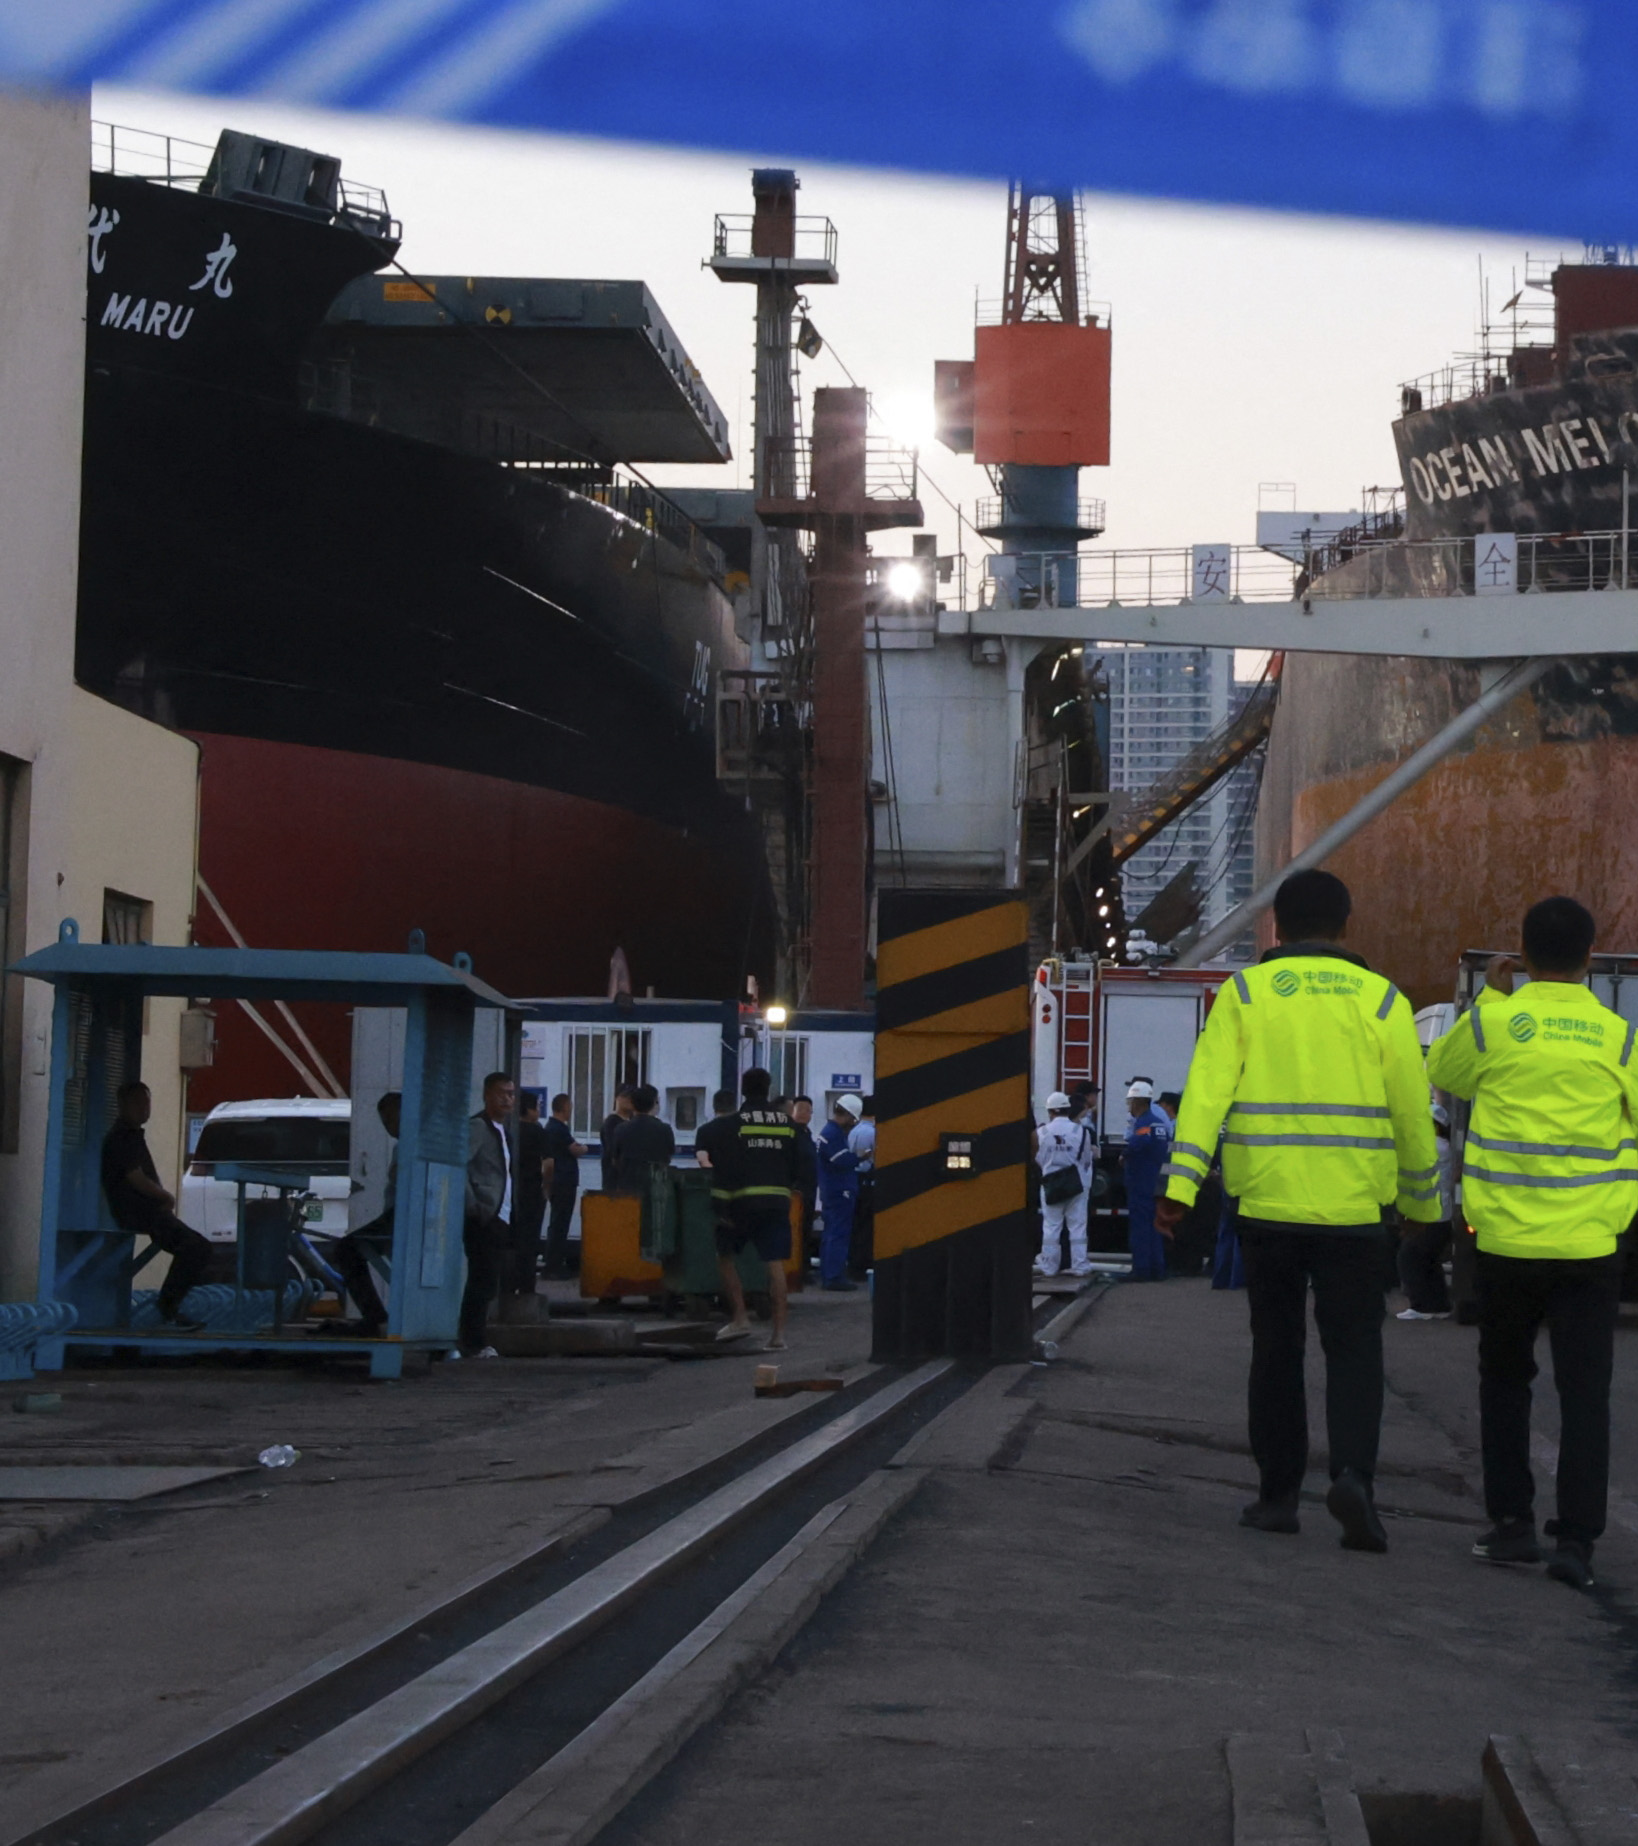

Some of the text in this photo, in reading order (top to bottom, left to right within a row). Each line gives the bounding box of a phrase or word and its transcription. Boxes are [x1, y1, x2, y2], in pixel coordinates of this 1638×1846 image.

[100, 292, 195, 340] MARU
[1409, 434, 1520, 506] OCEAN
[1195, 550, 1227, 598] 安
[1478, 541, 1511, 588] 全
[1303, 970, 1364, 989] 中国移动
[1305, 986, 1331, 995] China
[1542, 1017, 1604, 1036] 中国移动
[1543, 1031, 1571, 1041] China
